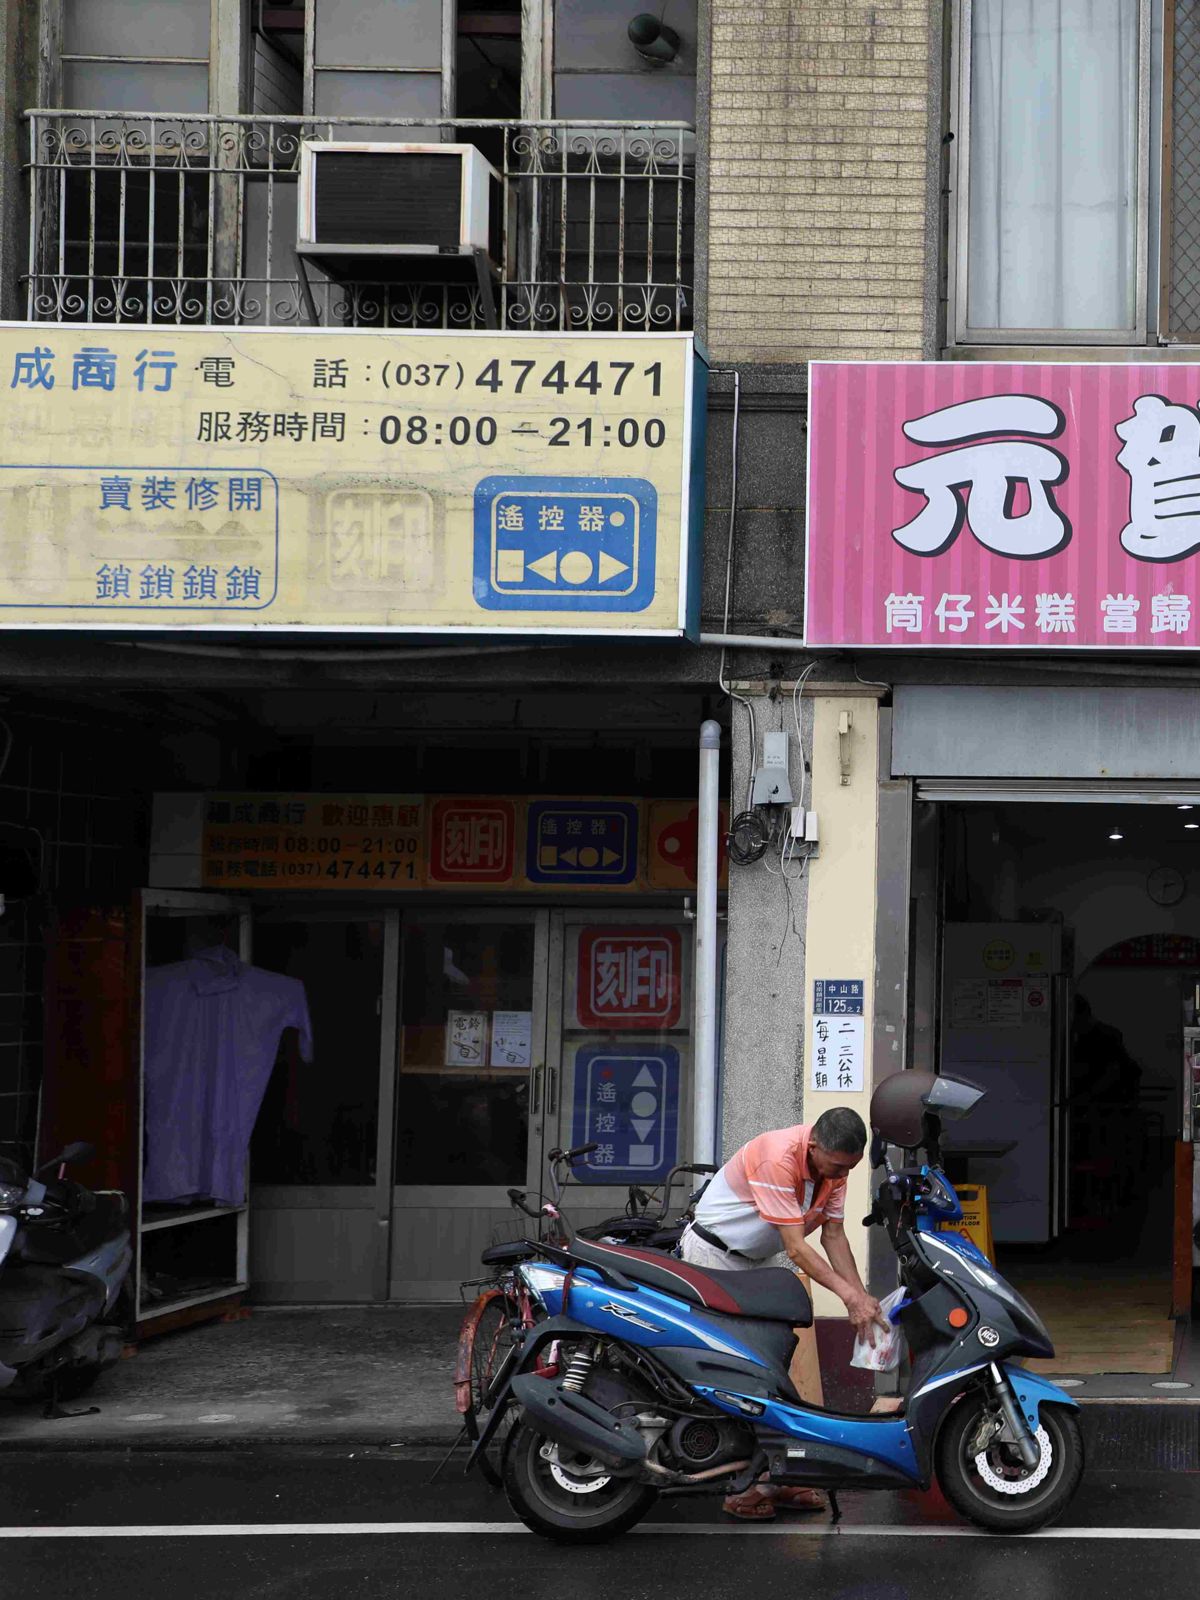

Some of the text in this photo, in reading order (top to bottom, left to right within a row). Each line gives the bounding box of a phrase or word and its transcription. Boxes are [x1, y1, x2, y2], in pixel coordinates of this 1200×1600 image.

[10, 346, 178, 391] 成商行
[475, 358, 665, 397] 474471
[498, 504, 606, 532] 遙控器
[884, 592, 1076, 635] 筒仔米糕
[445, 815, 503, 868] 刻印
[541, 818, 607, 836] 遙控器
[326, 860, 418, 880] 474471
[596, 944, 670, 1014] 刻印
[828, 984, 859, 994] 中山路
[815, 1020, 829, 1089] 每星期
[594, 1082, 617, 1164] 遙控器
